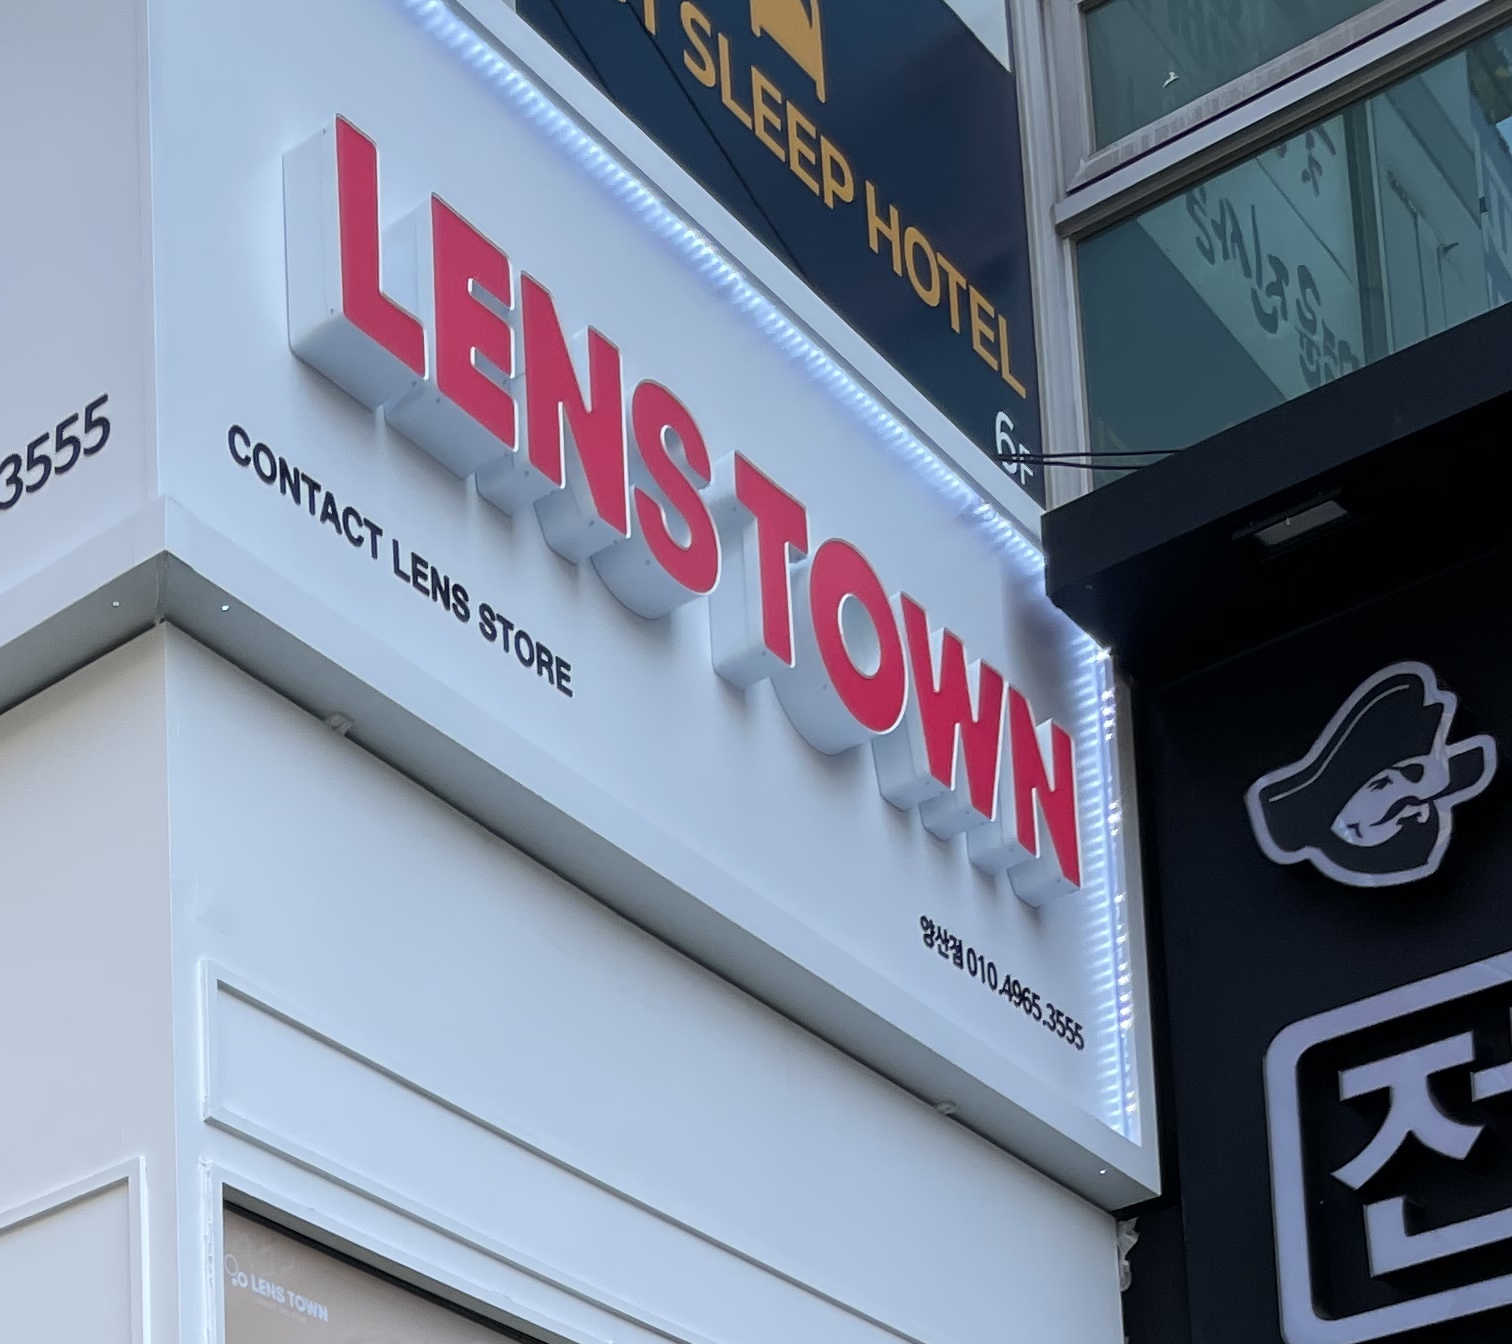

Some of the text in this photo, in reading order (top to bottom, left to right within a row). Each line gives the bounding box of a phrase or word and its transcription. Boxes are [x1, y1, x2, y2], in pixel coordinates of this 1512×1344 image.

[680, 1, 1026, 399] SLEEP HOTEL
[228, 425, 574, 697] CONTACT LENS STORE
[920, 915, 1085, 1051] 양산점 010.4965.3555
[251, 1273, 286, 1303] LENS
[286, 1290, 329, 1322] TOWN
